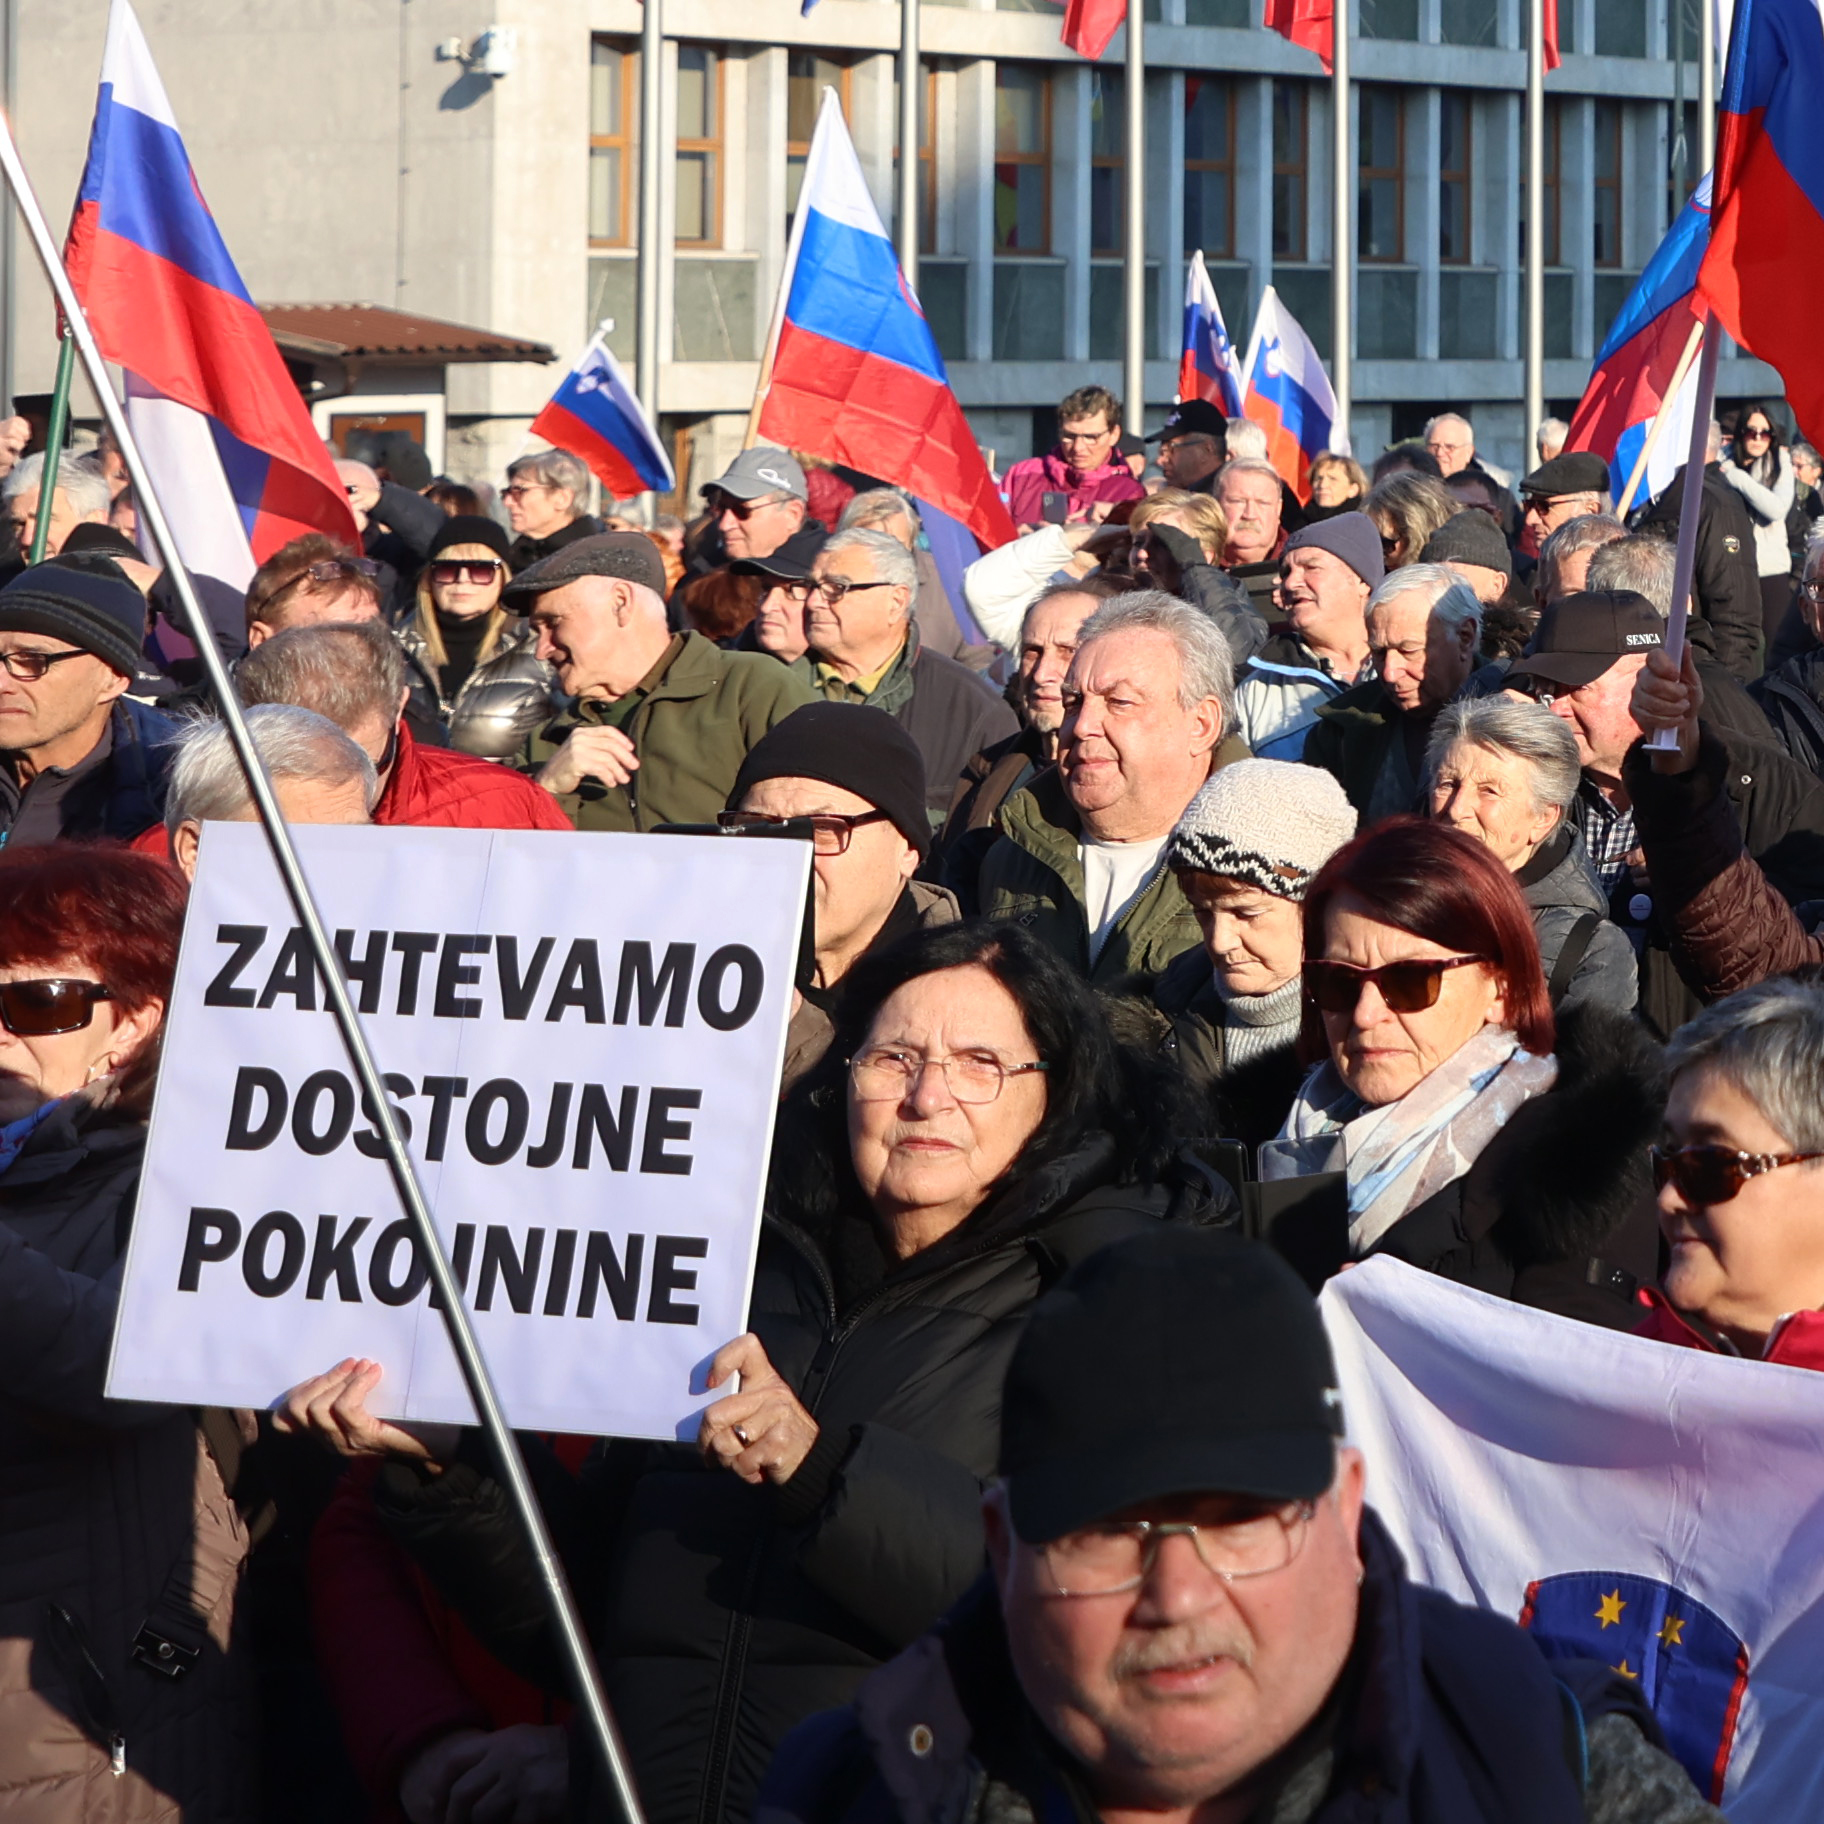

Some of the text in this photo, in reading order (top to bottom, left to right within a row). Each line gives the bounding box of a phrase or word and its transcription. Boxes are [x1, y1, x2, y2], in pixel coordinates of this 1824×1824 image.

[1626, 633, 1661, 646] SENICA
[204, 923, 765, 1032] ZAHTEVAMO
[225, 1066, 703, 1176] DOSTOJNE
[177, 1207, 710, 1326] POKOJNINE
